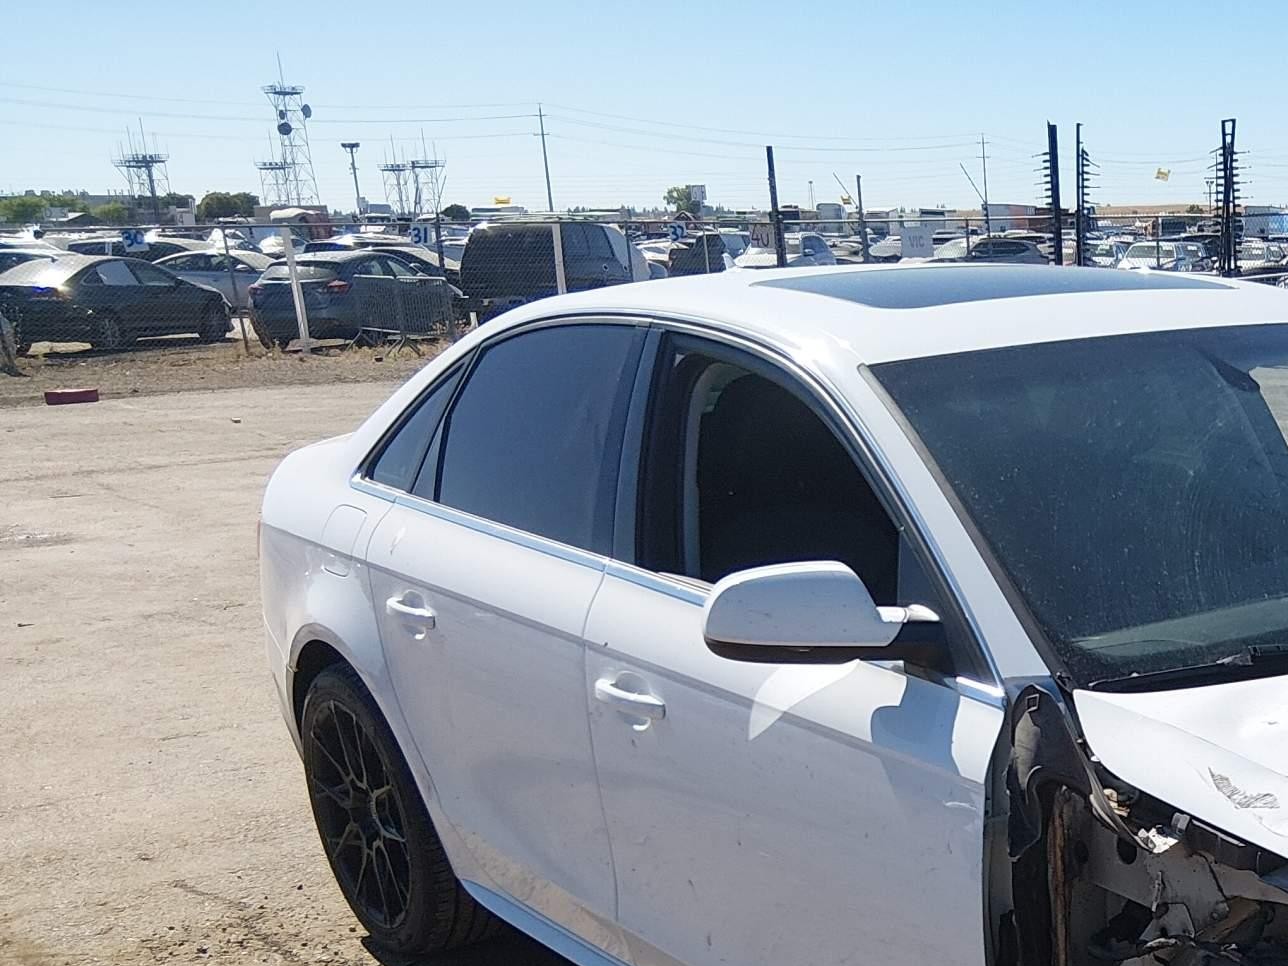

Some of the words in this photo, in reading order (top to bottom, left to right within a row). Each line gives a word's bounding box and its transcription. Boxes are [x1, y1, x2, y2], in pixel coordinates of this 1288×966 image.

[121, 230, 145, 248] 30
[412, 226, 428, 244] 31
[669, 224, 688, 242] 32
[908, 235, 926, 249] VIC
